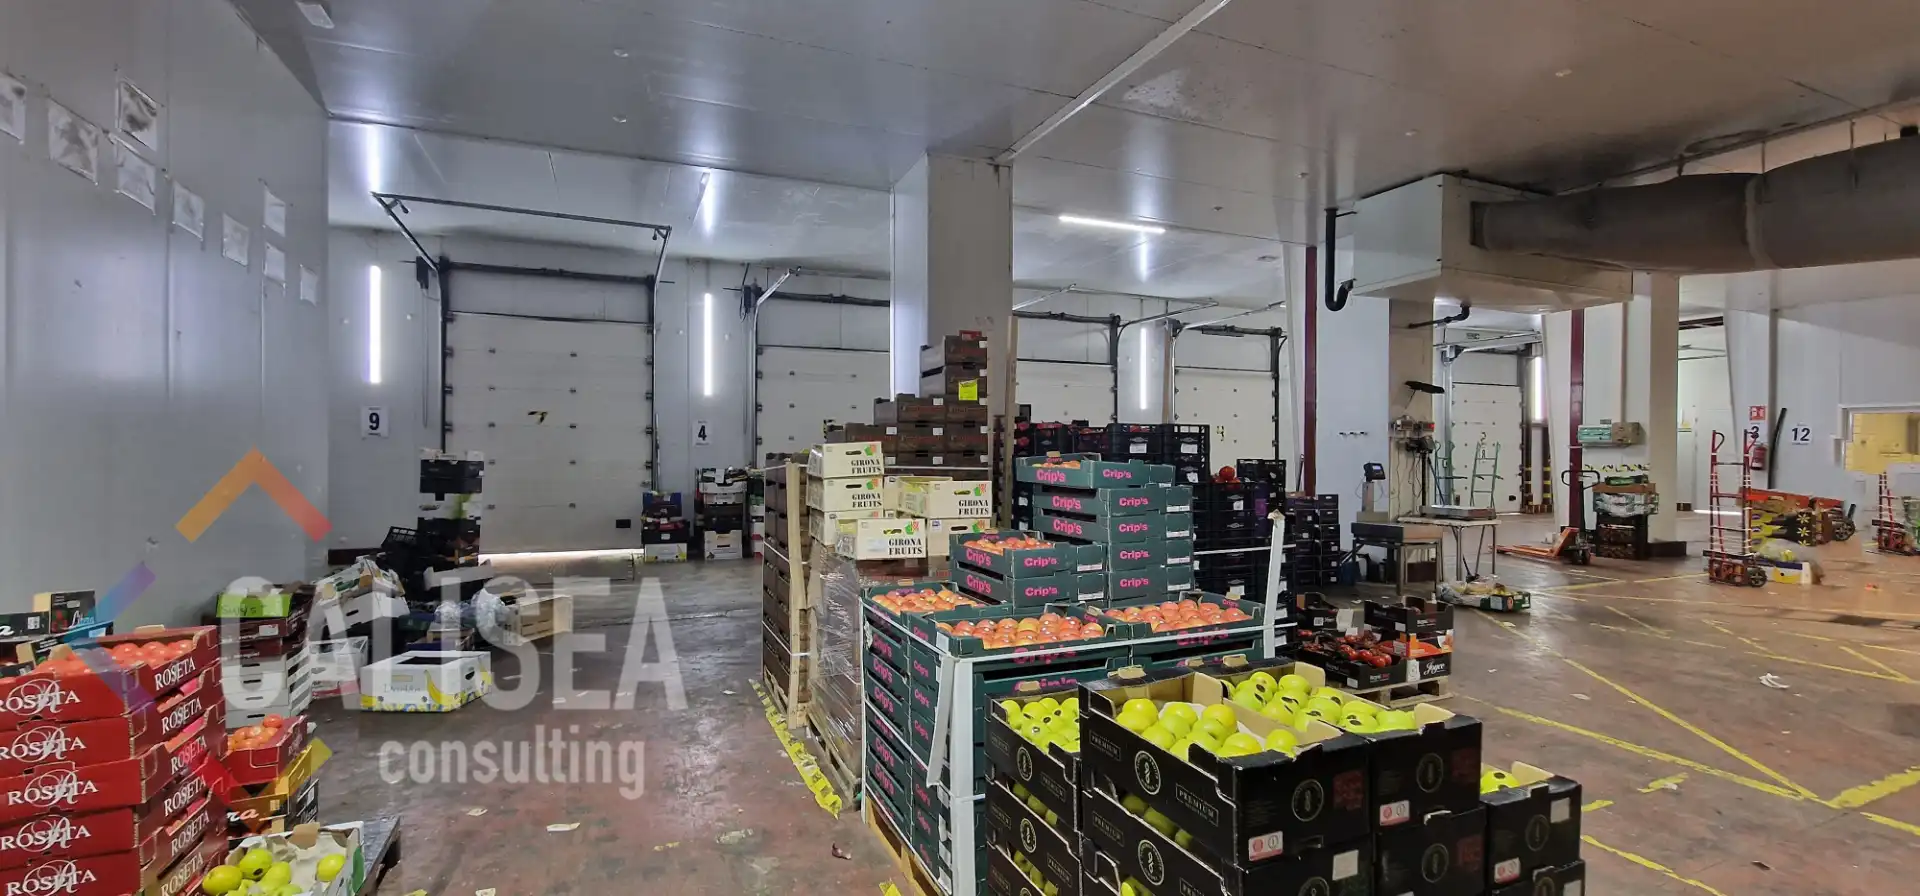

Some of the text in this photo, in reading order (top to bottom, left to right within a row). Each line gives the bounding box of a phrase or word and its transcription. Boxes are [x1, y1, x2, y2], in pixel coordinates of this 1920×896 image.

[369, 412, 380, 431] 9
[698, 425, 707, 441] 4
[1791, 427, 1812, 442] 12
[850, 459, 881, 467] GIRONA
[851, 466, 882, 475] FRUITS
[1036, 469, 1067, 483] Crip's
[1102, 468, 1133, 479] Crip's
[851, 493, 882, 501] GIRONA
[958, 499, 990, 508] GIRONA
[1052, 495, 1082, 510] Crip's
[1119, 497, 1149, 507] Crip's
[851, 500, 883, 509] FRUITS
[958, 507, 990, 516] FRUITS
[1053, 518, 1083, 535] Crip's
[1118, 523, 1149, 533] Crip's
[888, 538, 923, 547] GIRONA
[888, 546, 923, 556] FRUITS
[966, 547, 992, 567] Crip's
[1119, 550, 1150, 560] Crip's
[1024, 557, 1057, 567] Crip's
[966, 574, 992, 594] Crip's
[1119, 577, 1149, 588] Crip's
[1025, 587, 1058, 597] Crip's
[154, 656, 197, 691] ROSETA
[874, 687, 894, 713] Crip's
[161, 697, 203, 736] ROSETA
[1091, 735, 1119, 756] PREMIUM
[170, 734, 208, 776] ROSETA
[164, 774, 207, 817] ROSETA
[1179, 789, 1215, 817] PREMIUM
[171, 809, 210, 857] ROSETA
[160, 851, 204, 896] ROSETA
